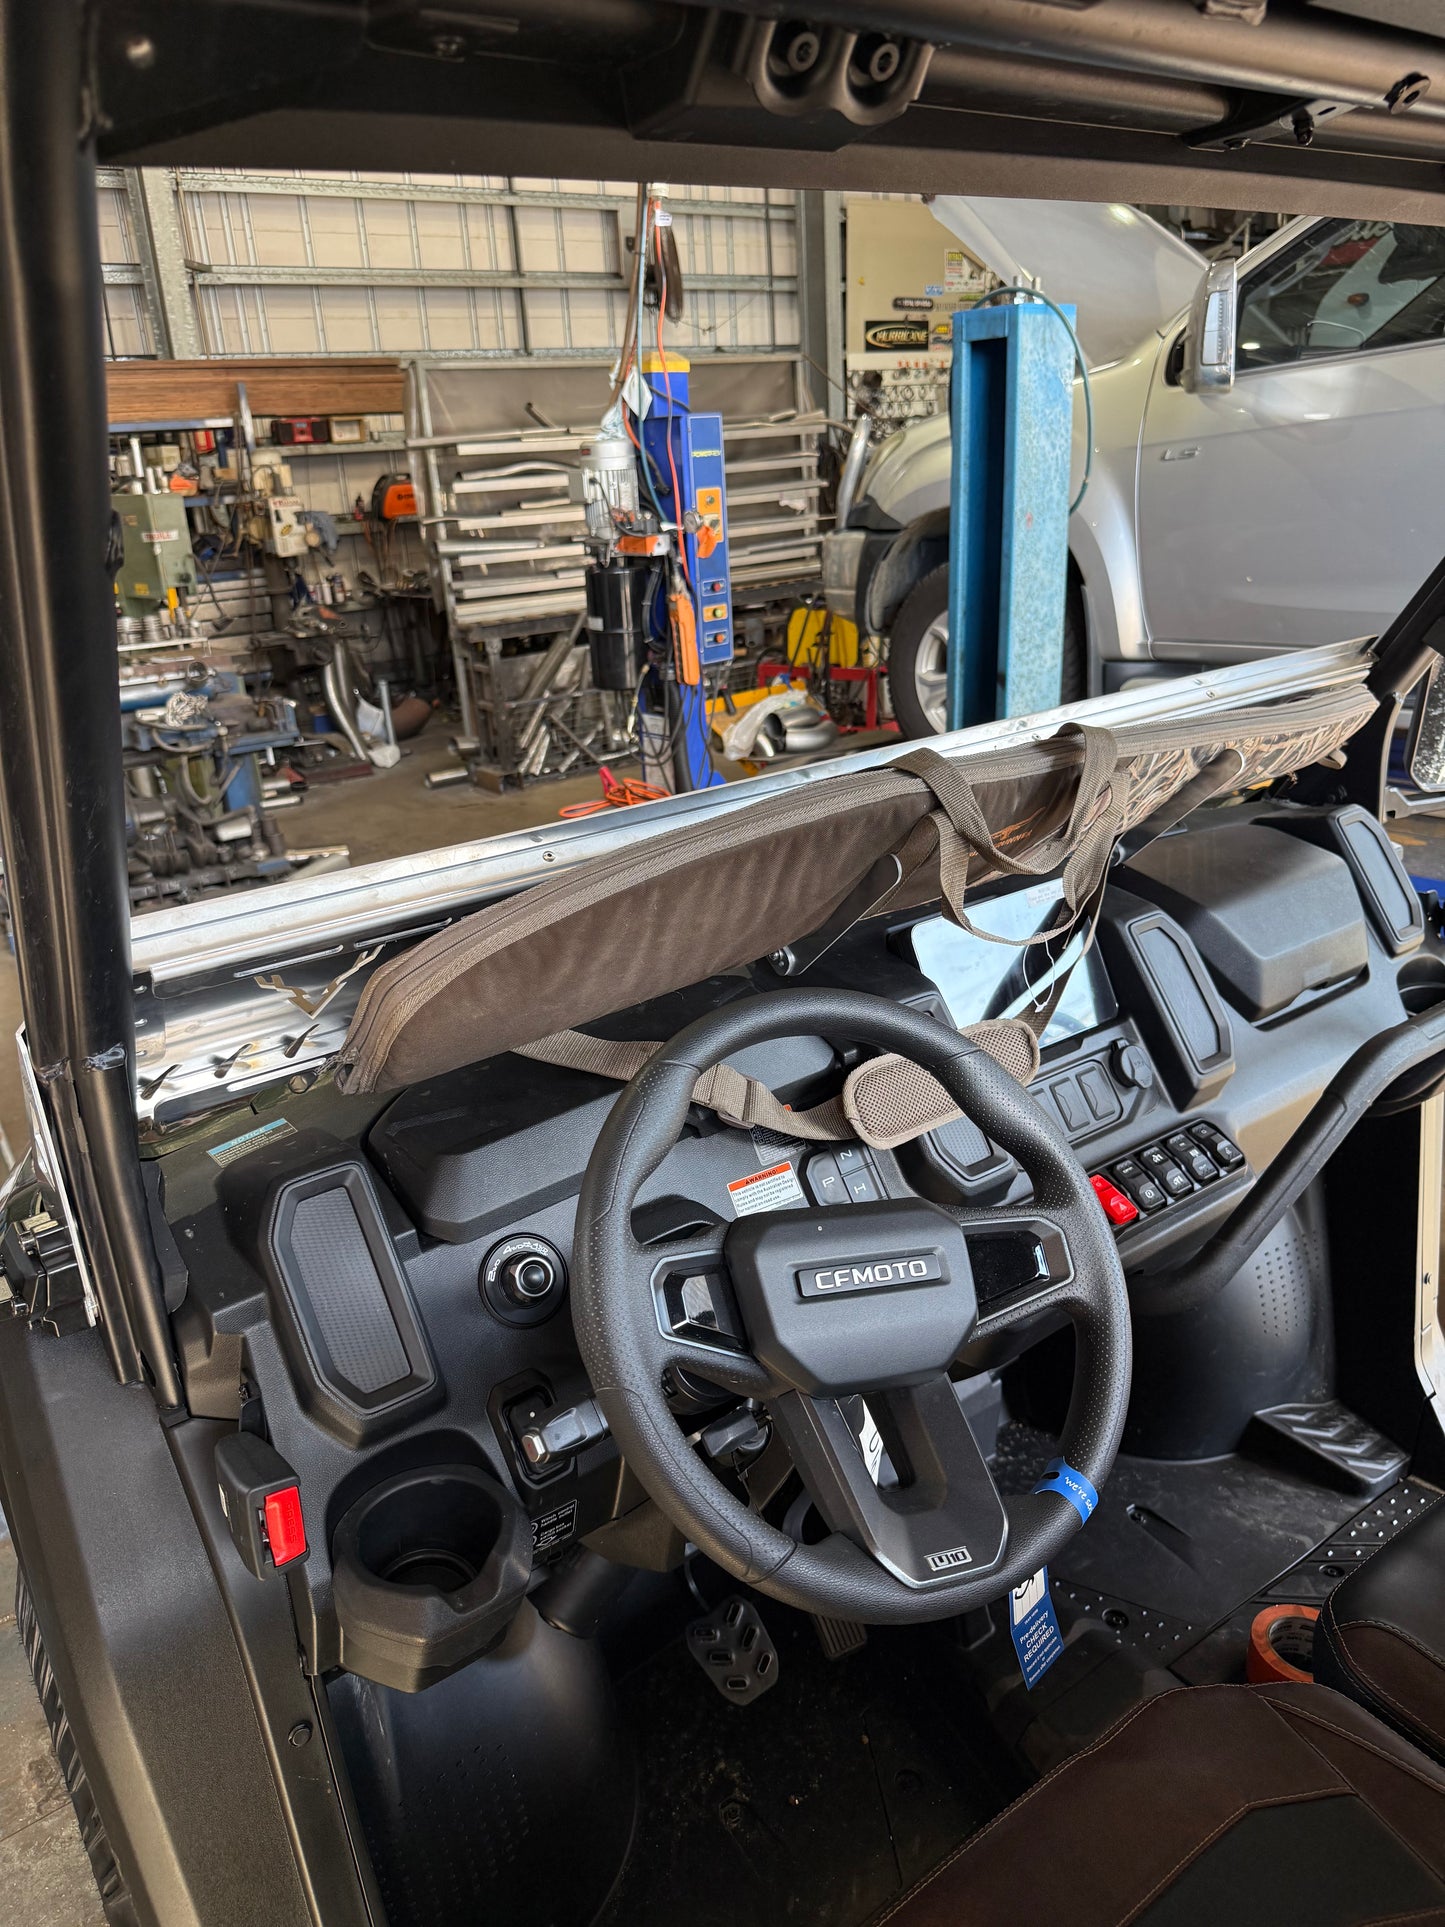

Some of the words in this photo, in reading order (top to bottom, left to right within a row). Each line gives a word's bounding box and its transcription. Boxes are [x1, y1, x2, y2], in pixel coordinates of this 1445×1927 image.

[840, 1149, 853, 1160] N
[822, 1176, 835, 1188] P
[853, 1183, 867, 1194] H
[815, 1260, 928, 1290] CFMOTO
[286, 1501, 297, 1544] PRESS
[930, 1550, 968, 1568] U10
[1020, 1610, 1049, 1645] Pre-delivery
[1026, 1622, 1048, 1648] CHECK
[1023, 1625, 1055, 1663] REQUIRED
